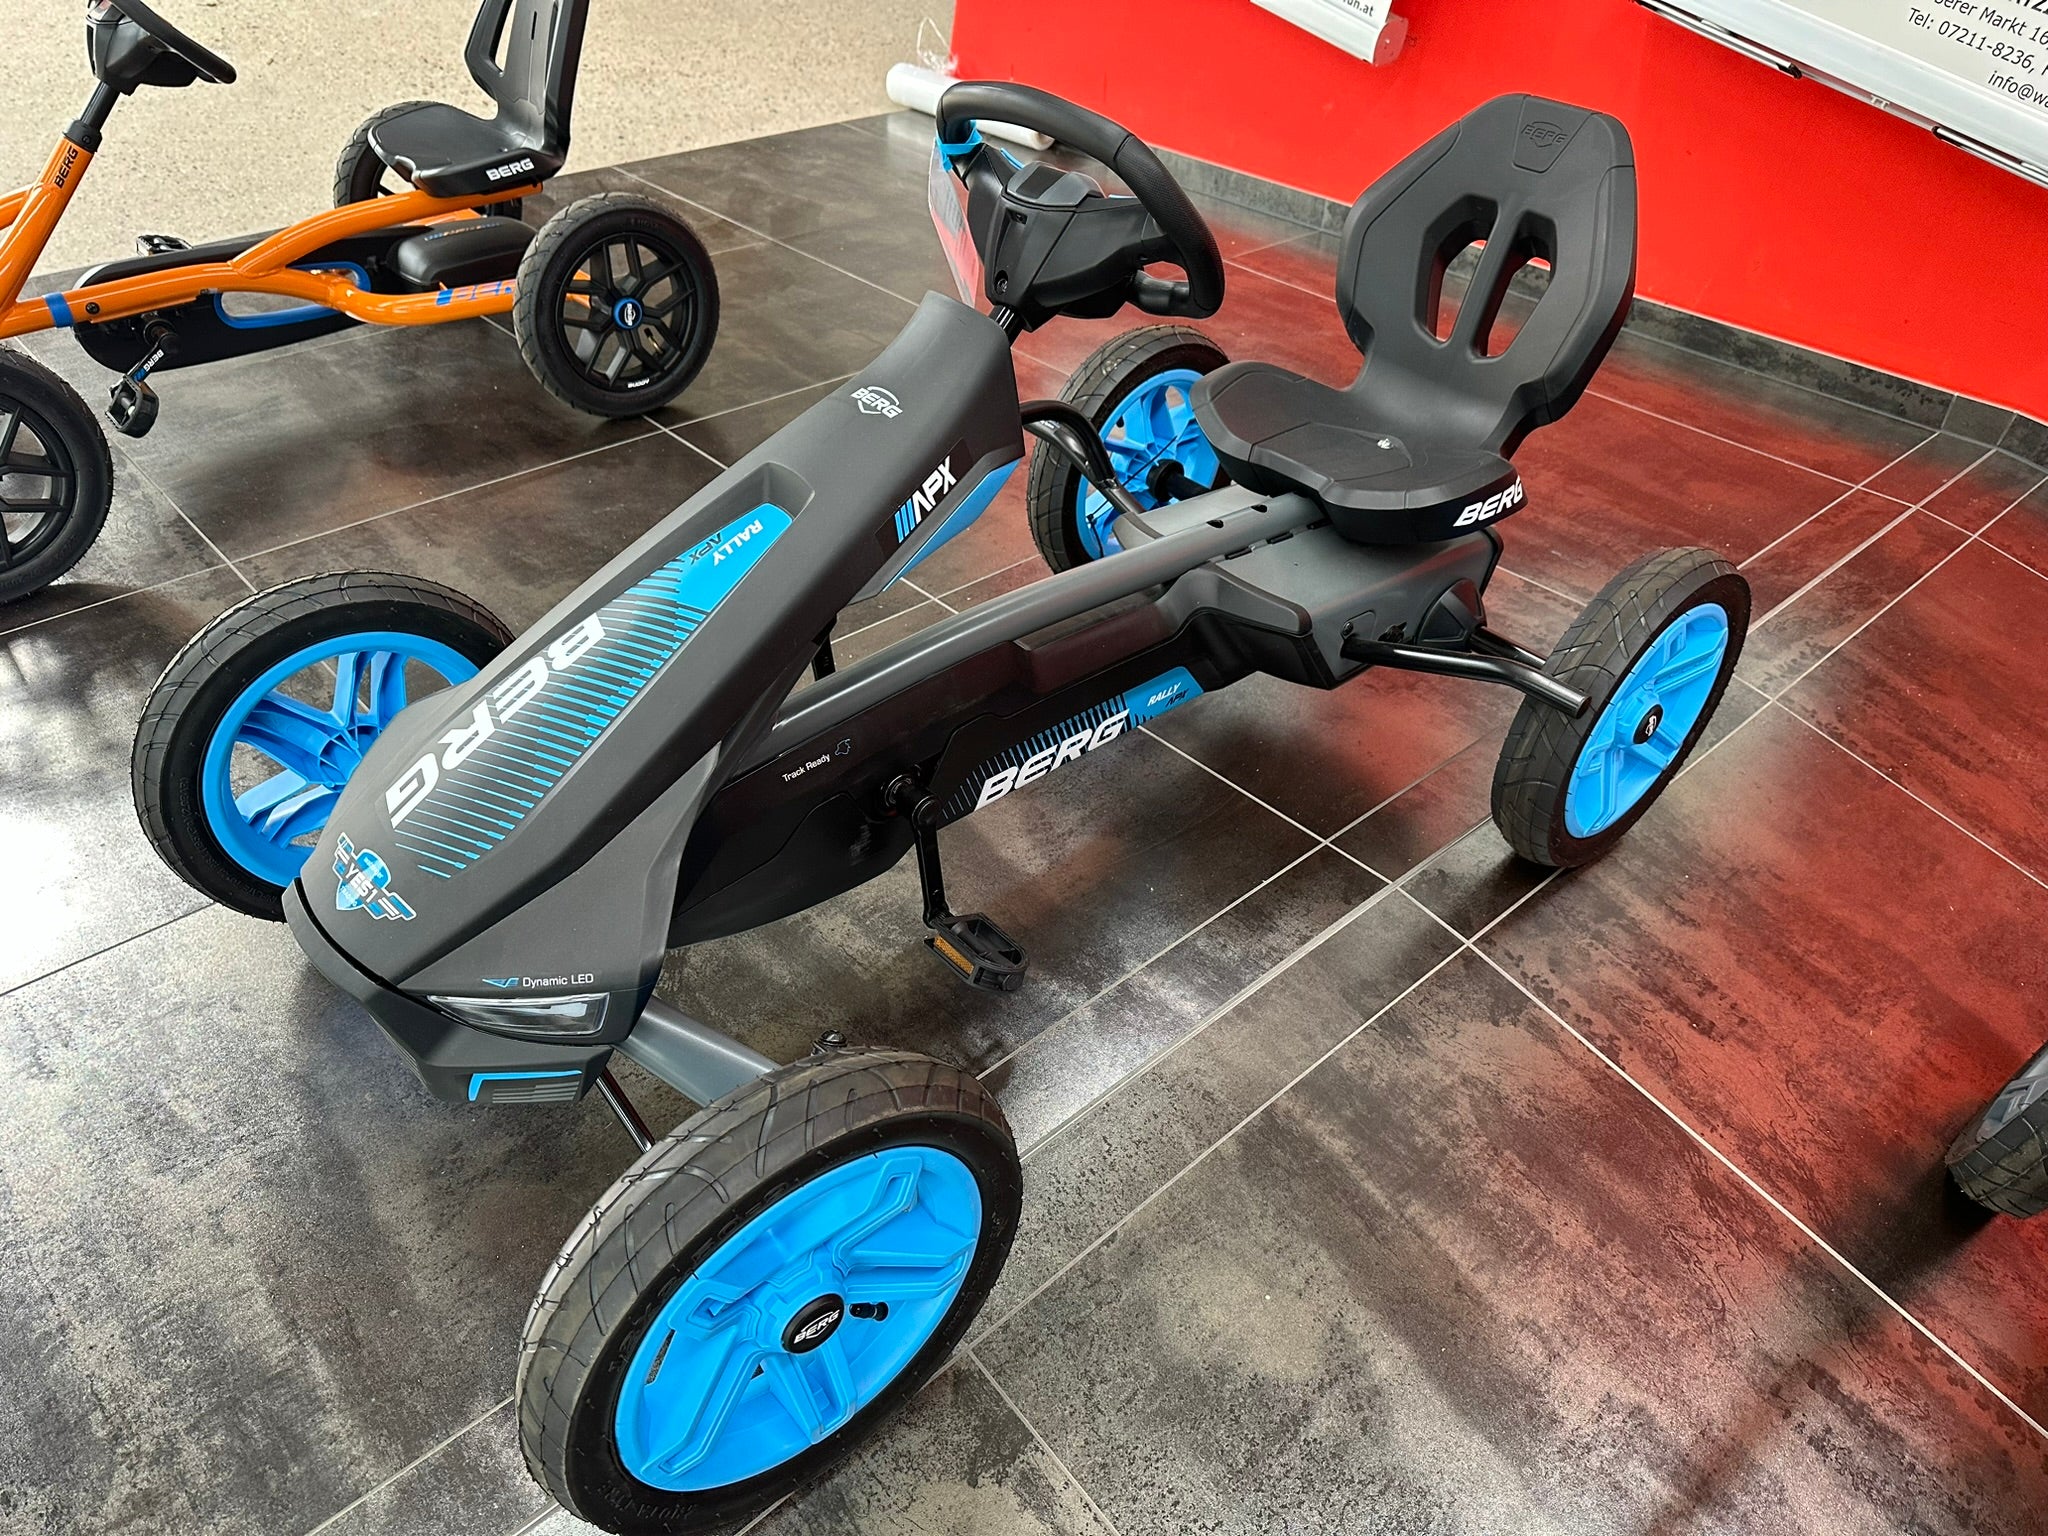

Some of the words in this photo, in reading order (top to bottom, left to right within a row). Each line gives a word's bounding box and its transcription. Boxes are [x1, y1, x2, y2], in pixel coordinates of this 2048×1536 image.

[1343, 0, 1374, 17] un.at
[1979, 7, 2027, 36] Markt
[1908, 7, 1935, 30] Tel:
[1938, 20, 2035, 74] 07211-8236,
[54, 145, 79, 189] BERG
[486, 158, 535, 181] BERG
[143, 349, 164, 372] BERG
[850, 387, 904, 419] BERG
[1453, 474, 1523, 527] BERG
[712, 519, 764, 567] RALLY
[1147, 681, 1182, 707] RALLY
[385, 613, 606, 829] BERG
[782, 766, 806, 782] Track
[805, 754, 831, 771] Ready
[974, 708, 1130, 811] BERG
[522, 975, 568, 989] Dynamic
[571, 973, 594, 985] LED
[793, 1309, 840, 1344] BERG
